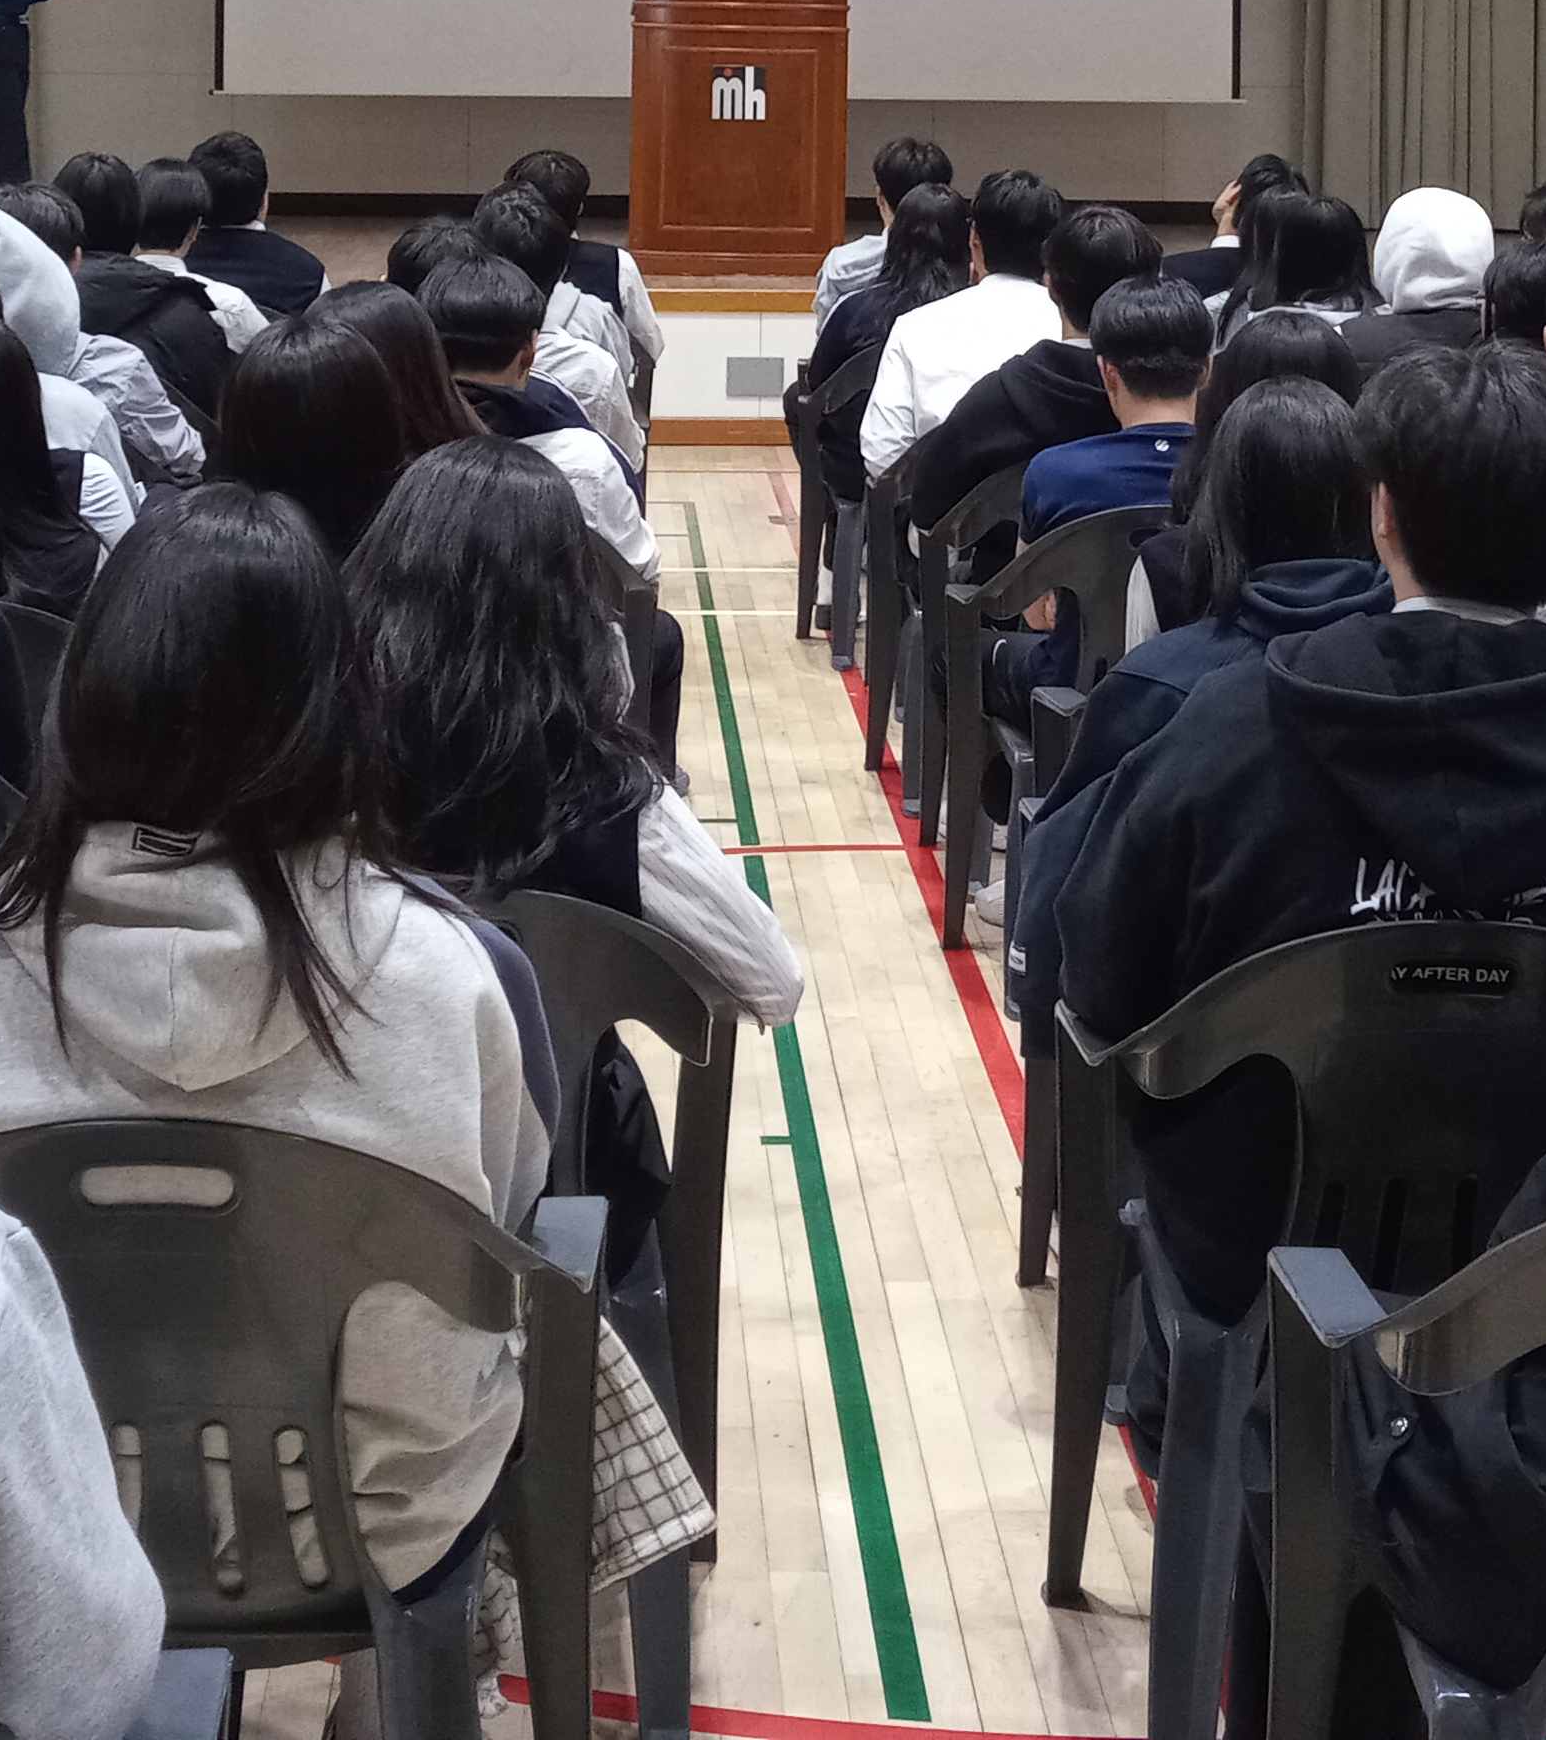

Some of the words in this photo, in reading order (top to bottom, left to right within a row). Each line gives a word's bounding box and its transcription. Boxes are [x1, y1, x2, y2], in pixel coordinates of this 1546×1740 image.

[711, 66, 766, 121] mh
[1391, 967, 1408, 980] Y
[1412, 967, 1470, 982] AFTER
[1475, 968, 1510, 983] DAY
